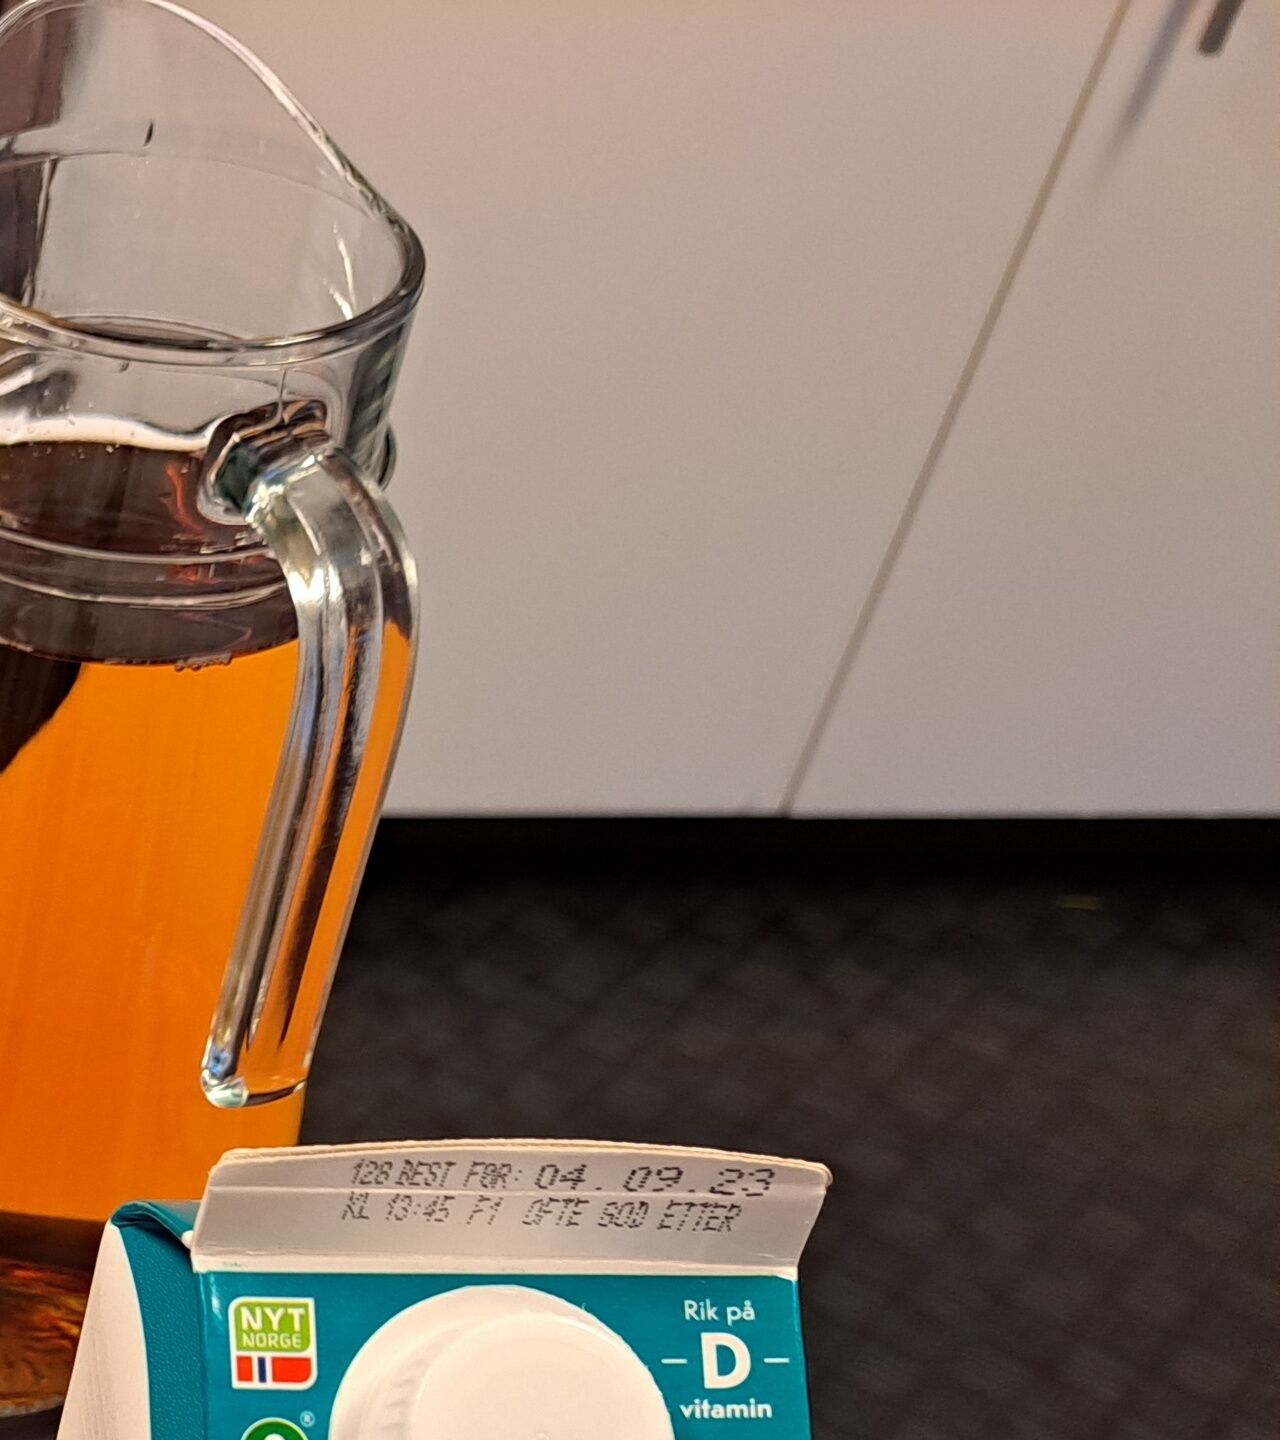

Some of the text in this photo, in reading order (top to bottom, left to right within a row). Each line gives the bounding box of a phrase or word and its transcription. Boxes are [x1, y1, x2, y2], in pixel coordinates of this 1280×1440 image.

[395, 1159, 457, 1187] BEST
[241, 1306, 306, 1331] NYT
[684, 1299, 756, 1326] Rik på
[242, 1332, 302, 1348] NORGE
[700, 1331, 752, 1389] D
[679, 1397, 773, 1419] vitamin
